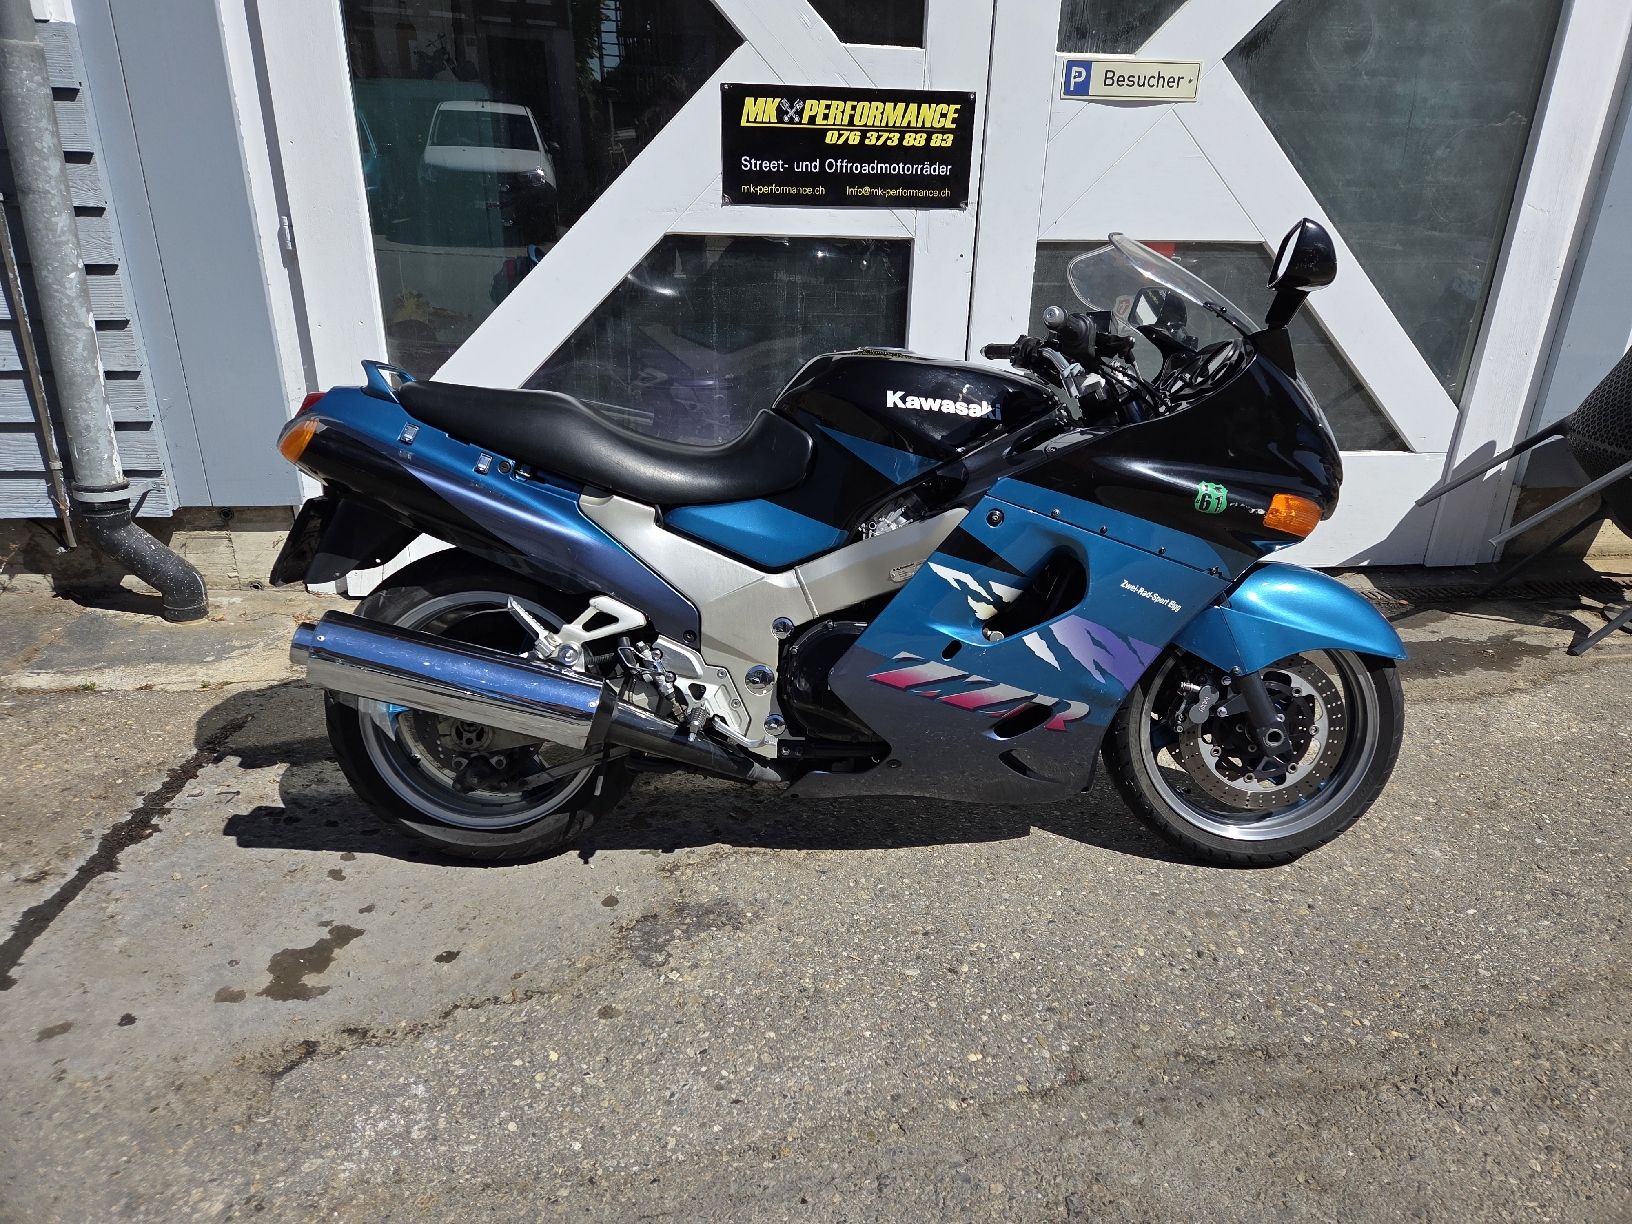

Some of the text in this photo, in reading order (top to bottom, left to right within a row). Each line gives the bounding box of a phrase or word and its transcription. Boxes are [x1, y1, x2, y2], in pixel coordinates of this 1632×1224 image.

[1070, 67, 1184, 91] P Besucher
[742, 97, 961, 129] MK PERFORMANCE
[825, 130, 954, 147] 076 373 88 83
[741, 156, 952, 176] Street- und Offroadmotorräder
[741, 183, 826, 197] mk-performance.ch
[886, 390, 1002, 420] Kawasaki
